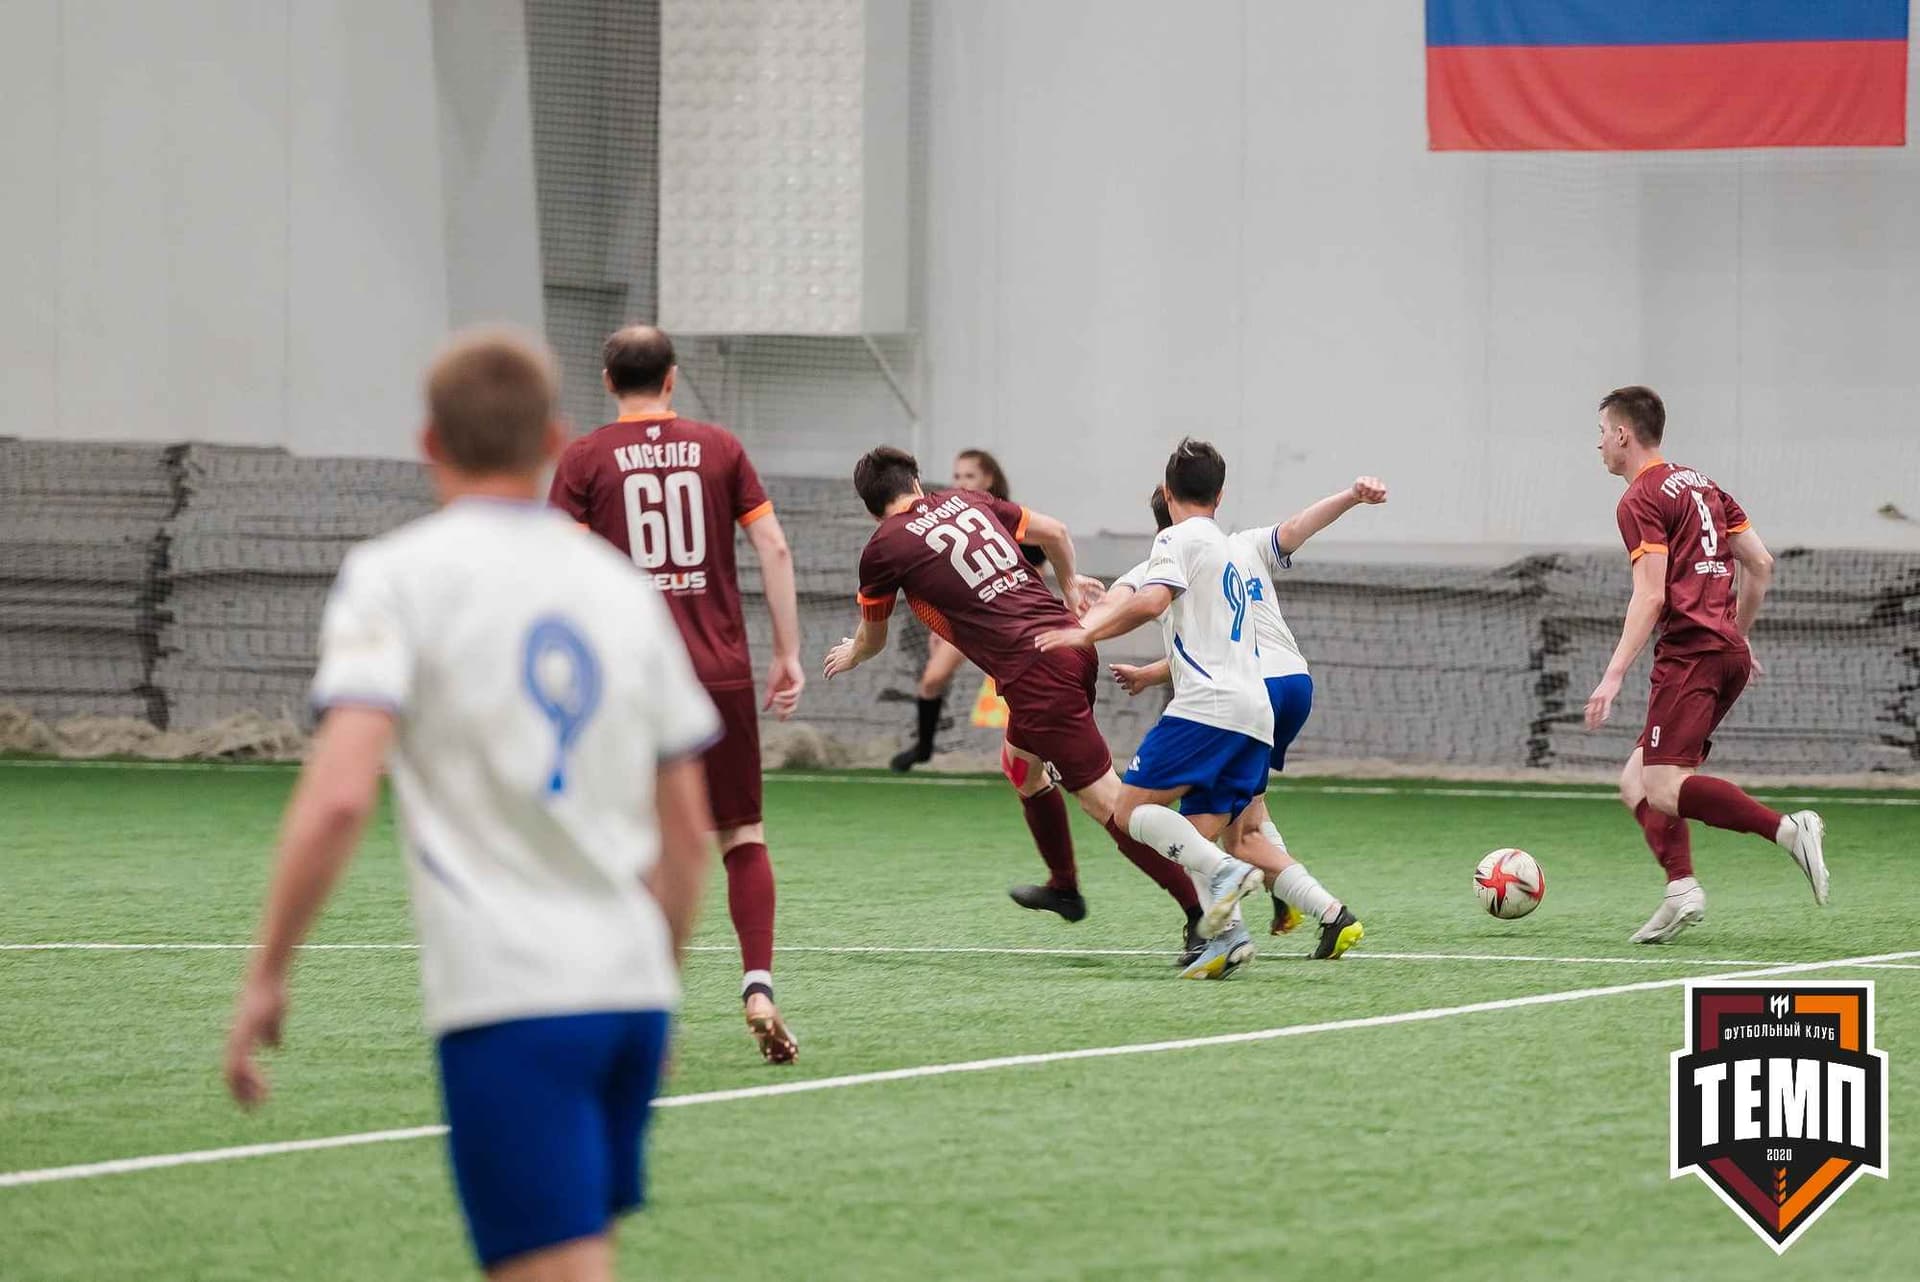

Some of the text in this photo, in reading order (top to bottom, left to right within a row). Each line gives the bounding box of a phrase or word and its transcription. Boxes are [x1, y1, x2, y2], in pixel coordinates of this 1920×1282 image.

[614, 441, 701, 472] КИСЕЛЕВ
[623, 471, 706, 569] 60
[926, 508, 1018, 589] 23
[1691, 490, 1718, 557] 9
[978, 568, 1029, 603] SEUS
[1222, 561, 1246, 642] 9
[1650, 725, 1661, 748] 9
